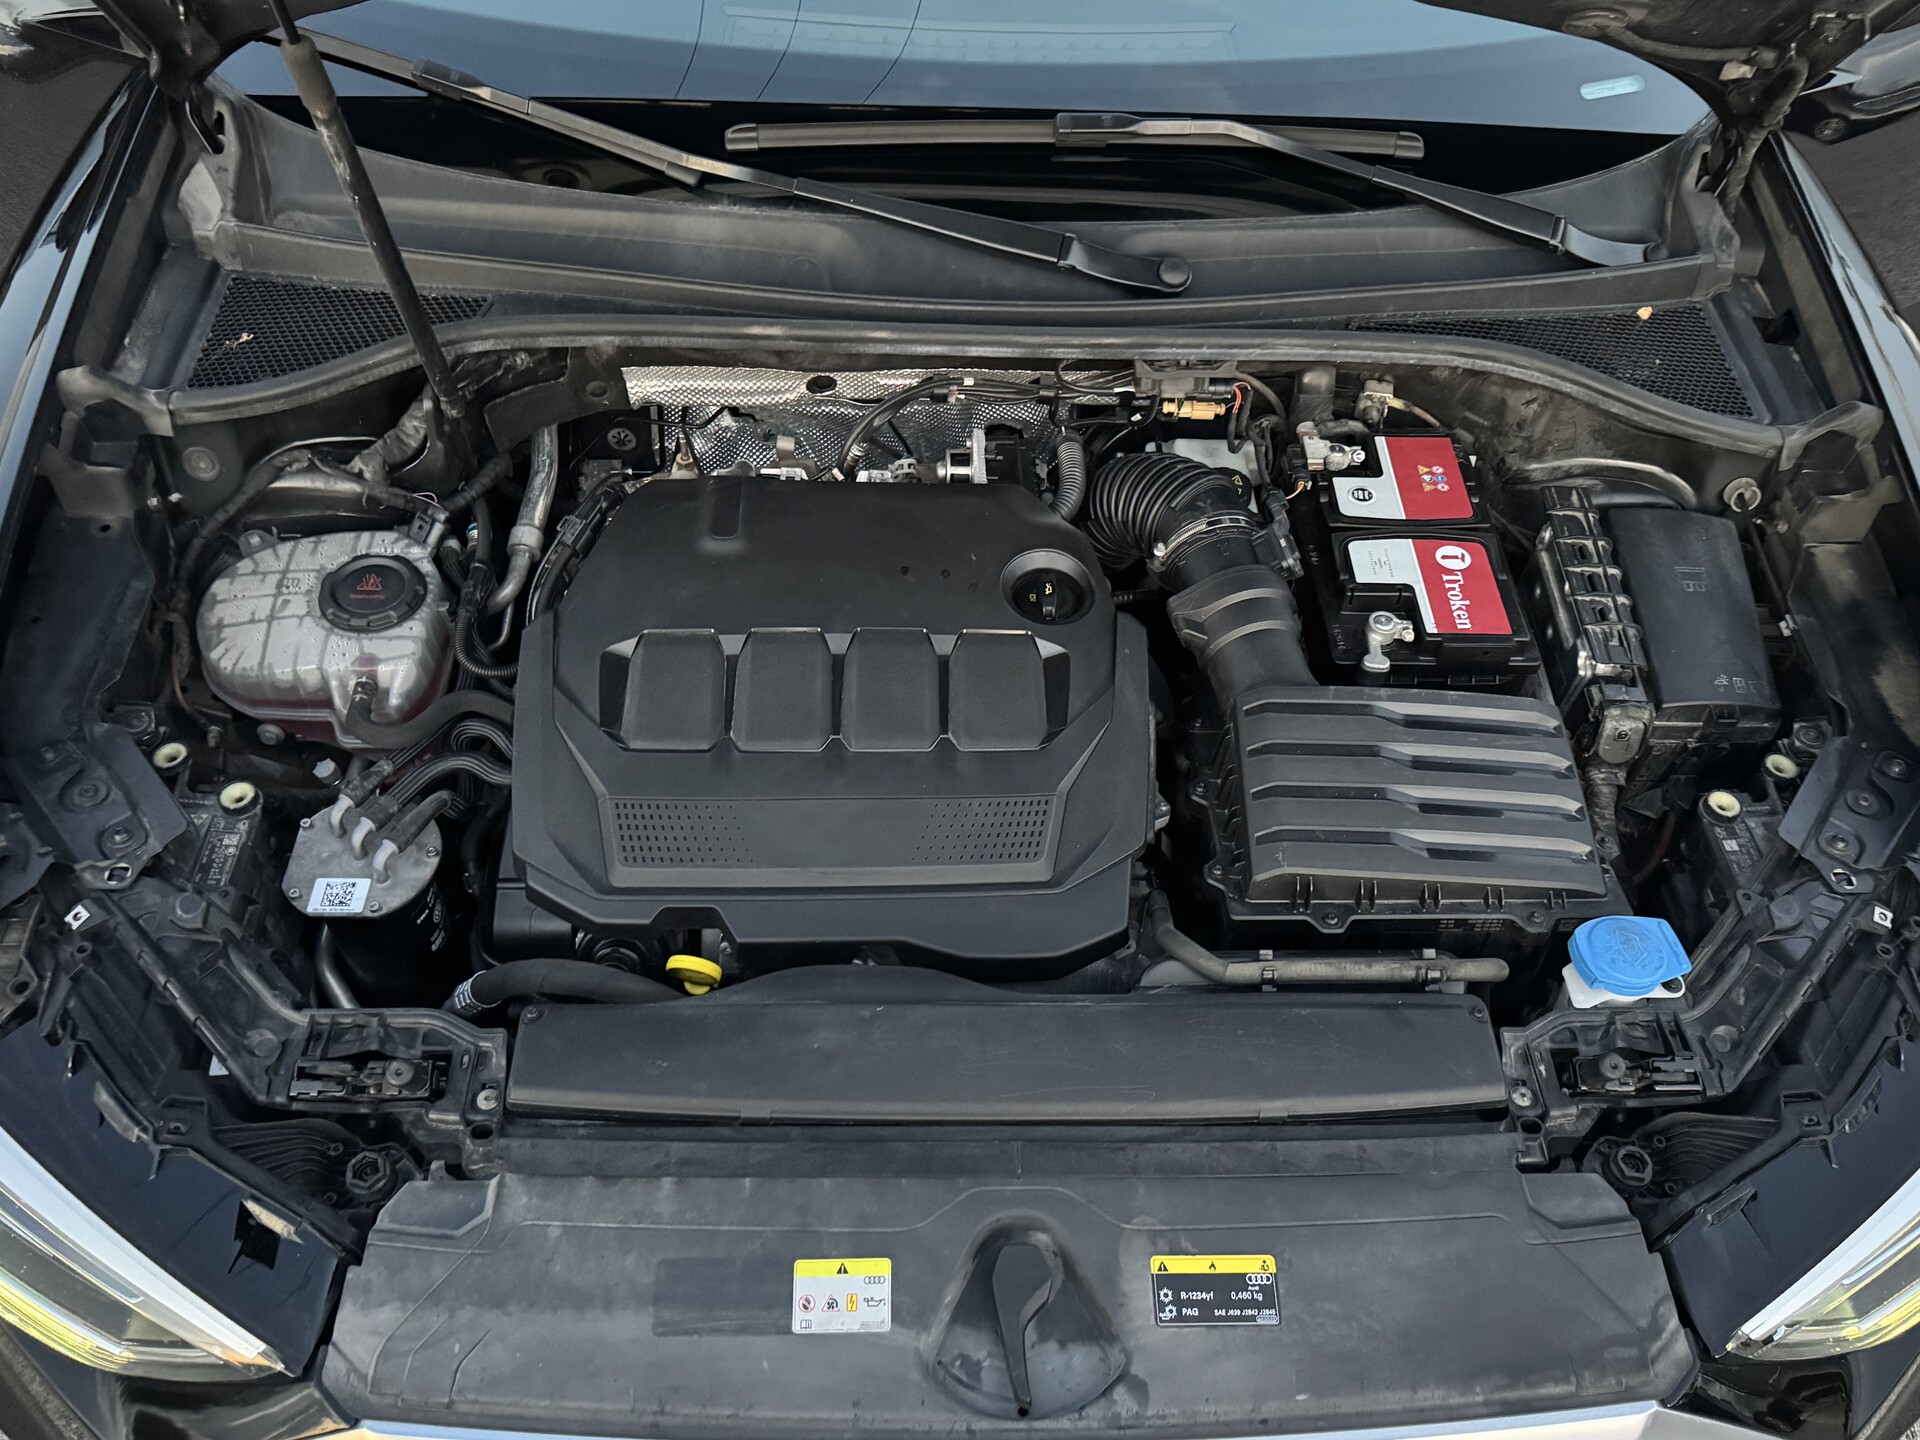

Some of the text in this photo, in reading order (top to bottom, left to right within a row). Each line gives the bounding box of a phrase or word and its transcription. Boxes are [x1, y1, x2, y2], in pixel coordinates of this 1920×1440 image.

[1441, 571, 1472, 629] Troken
[1180, 1291, 1214, 1301] R-1234yf
[1253, 1291, 1263, 1301] kg
[1182, 1308, 1199, 1316] PAG
